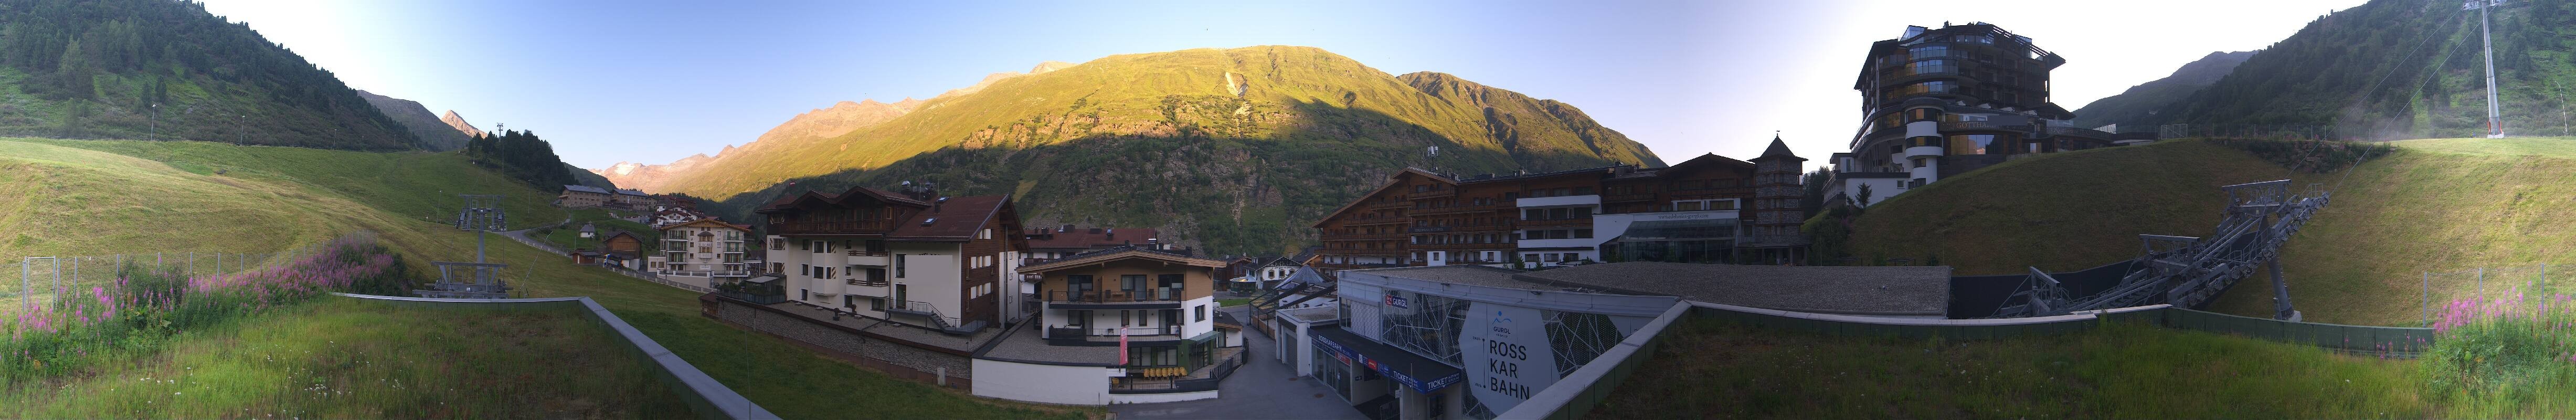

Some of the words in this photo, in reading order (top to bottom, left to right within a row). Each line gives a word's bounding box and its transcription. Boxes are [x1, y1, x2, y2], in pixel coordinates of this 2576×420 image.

[1393, 298, 1407, 307] GURGL
[1493, 326, 1511, 334] GURGL
[1318, 334, 1342, 352] ROSSKARBAHN
[1490, 340, 1527, 361] ROSS
[1490, 358, 1518, 379] KAR
[1393, 370, 1408, 383] TICKET
[1427, 377, 1447, 390] TICKET
[1490, 376, 1530, 400] BAHN
